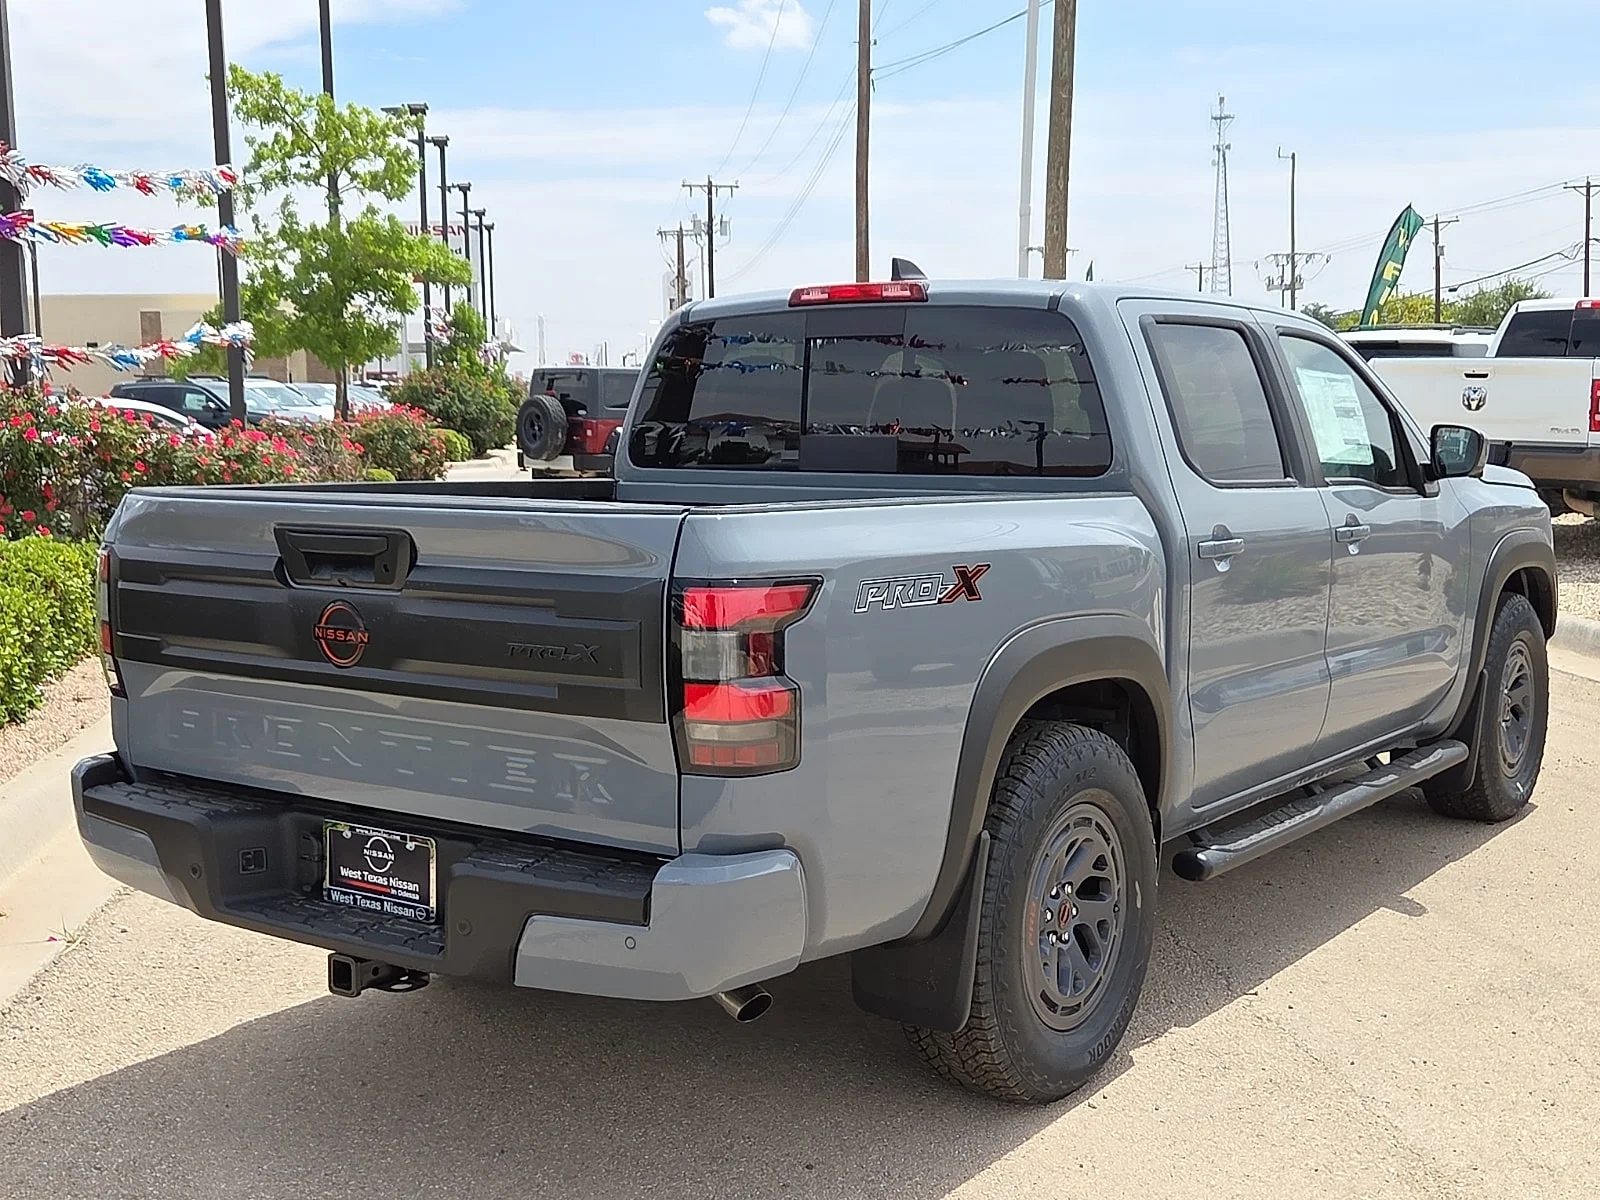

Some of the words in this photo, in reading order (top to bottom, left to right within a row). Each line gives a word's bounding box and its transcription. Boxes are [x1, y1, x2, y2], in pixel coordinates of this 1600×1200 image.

[852, 562, 991, 614] PRO-X
[315, 627, 369, 643] NISSAN
[506, 642, 601, 665] PRO-X
[168, 704, 615, 806] FRONTIER
[363, 848, 395, 861] NISSAN
[340, 866, 362, 880] West
[363, 871, 388, 885] Texas
[389, 877, 419, 892] Nissan
[331, 890, 354, 904] West
[355, 895, 381, 910] Texas
[383, 901, 415, 918] Nissan
